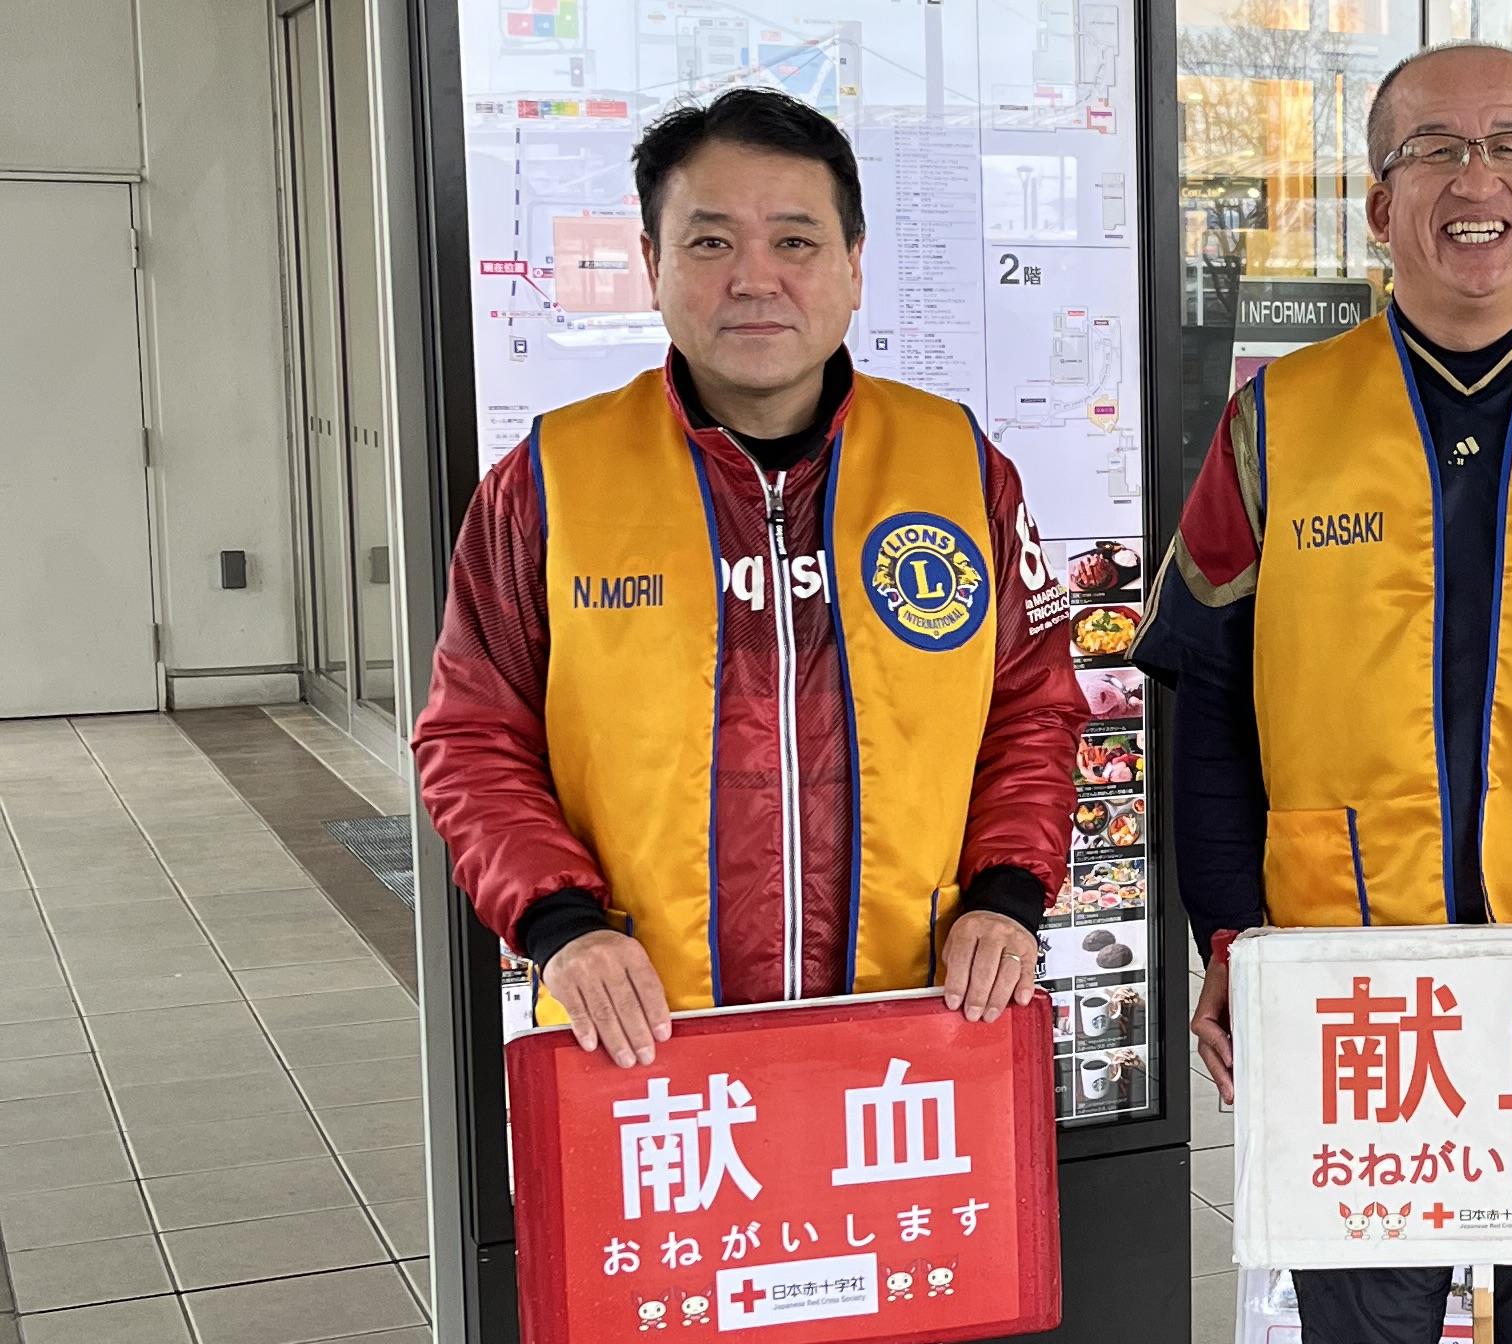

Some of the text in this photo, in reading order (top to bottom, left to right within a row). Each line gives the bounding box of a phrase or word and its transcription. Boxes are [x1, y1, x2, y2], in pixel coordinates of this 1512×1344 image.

[999, 253, 1042, 286] 2階
[1241, 301, 1361, 325] INFORMATION
[886, 529, 951, 554] LIONS
[1292, 511, 1384, 550] Y.SASAKI
[573, 574, 664, 610] N.MORII
[909, 560, 945, 599] L
[903, 607, 965, 630] INTERNATIONAL
[612, 1057, 972, 1220] 献血
[602, 1197, 990, 1276] おねがいします
[772, 1276, 865, 1300] 日本赤十字社
